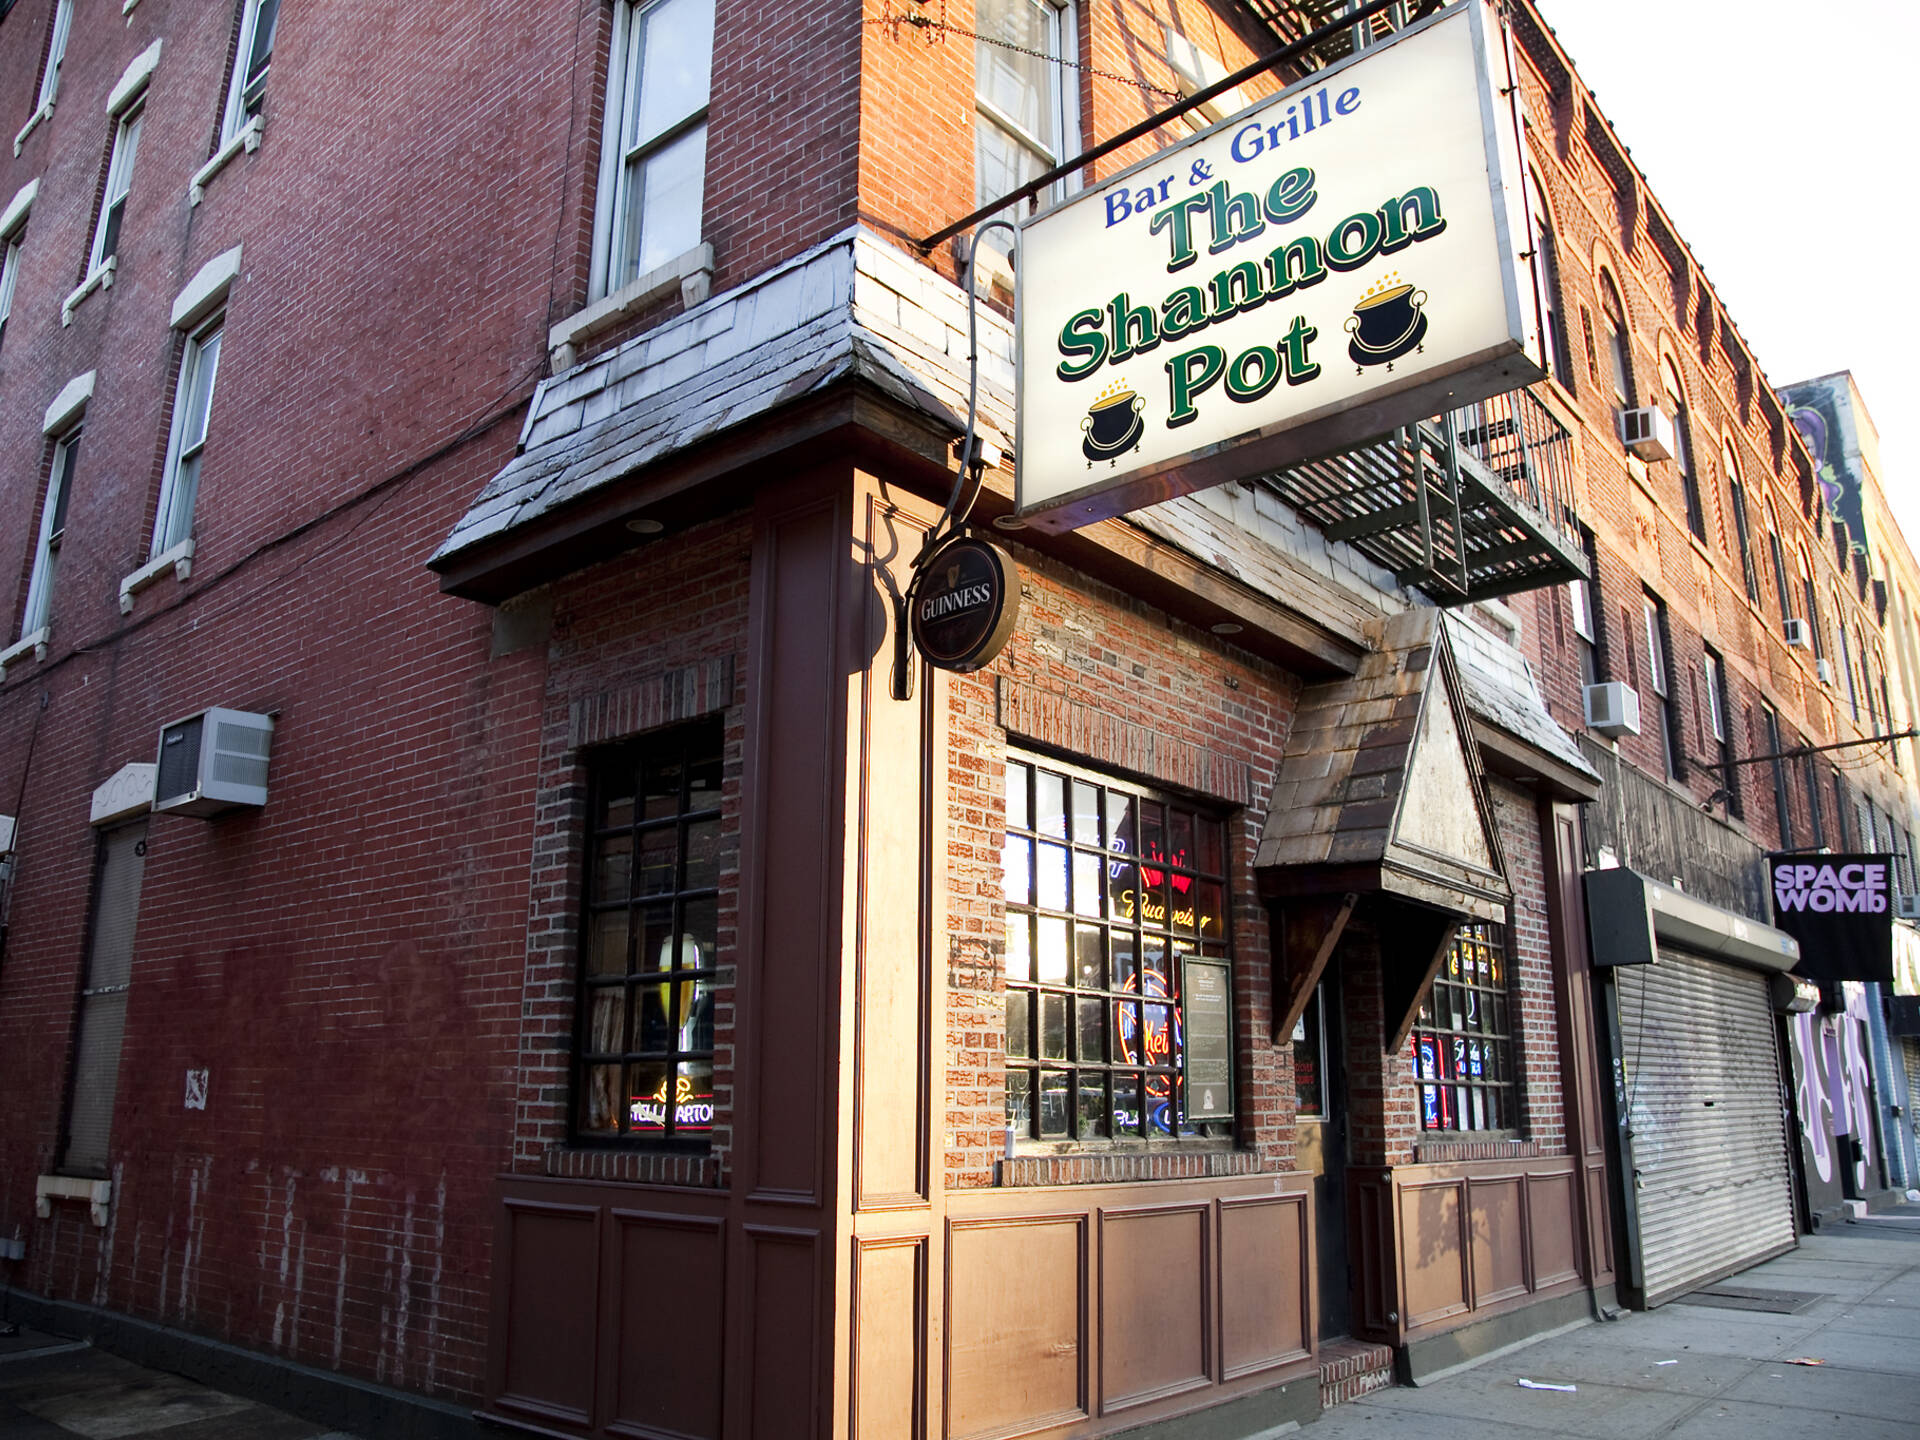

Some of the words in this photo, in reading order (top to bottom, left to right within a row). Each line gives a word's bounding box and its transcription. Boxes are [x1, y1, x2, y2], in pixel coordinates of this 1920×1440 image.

[1104, 174, 1175, 229] Bar
[1189, 158, 1214, 186] &
[1230, 86, 1362, 164] Grille
[1149, 166, 1317, 273] The
[1057, 184, 1447, 383] Shannon
[1166, 315, 1321, 429] Pot
[921, 582, 991, 621] GUINNESS
[1121, 890, 1212, 928] Budeisr
[1774, 863, 1887, 889] SPACE
